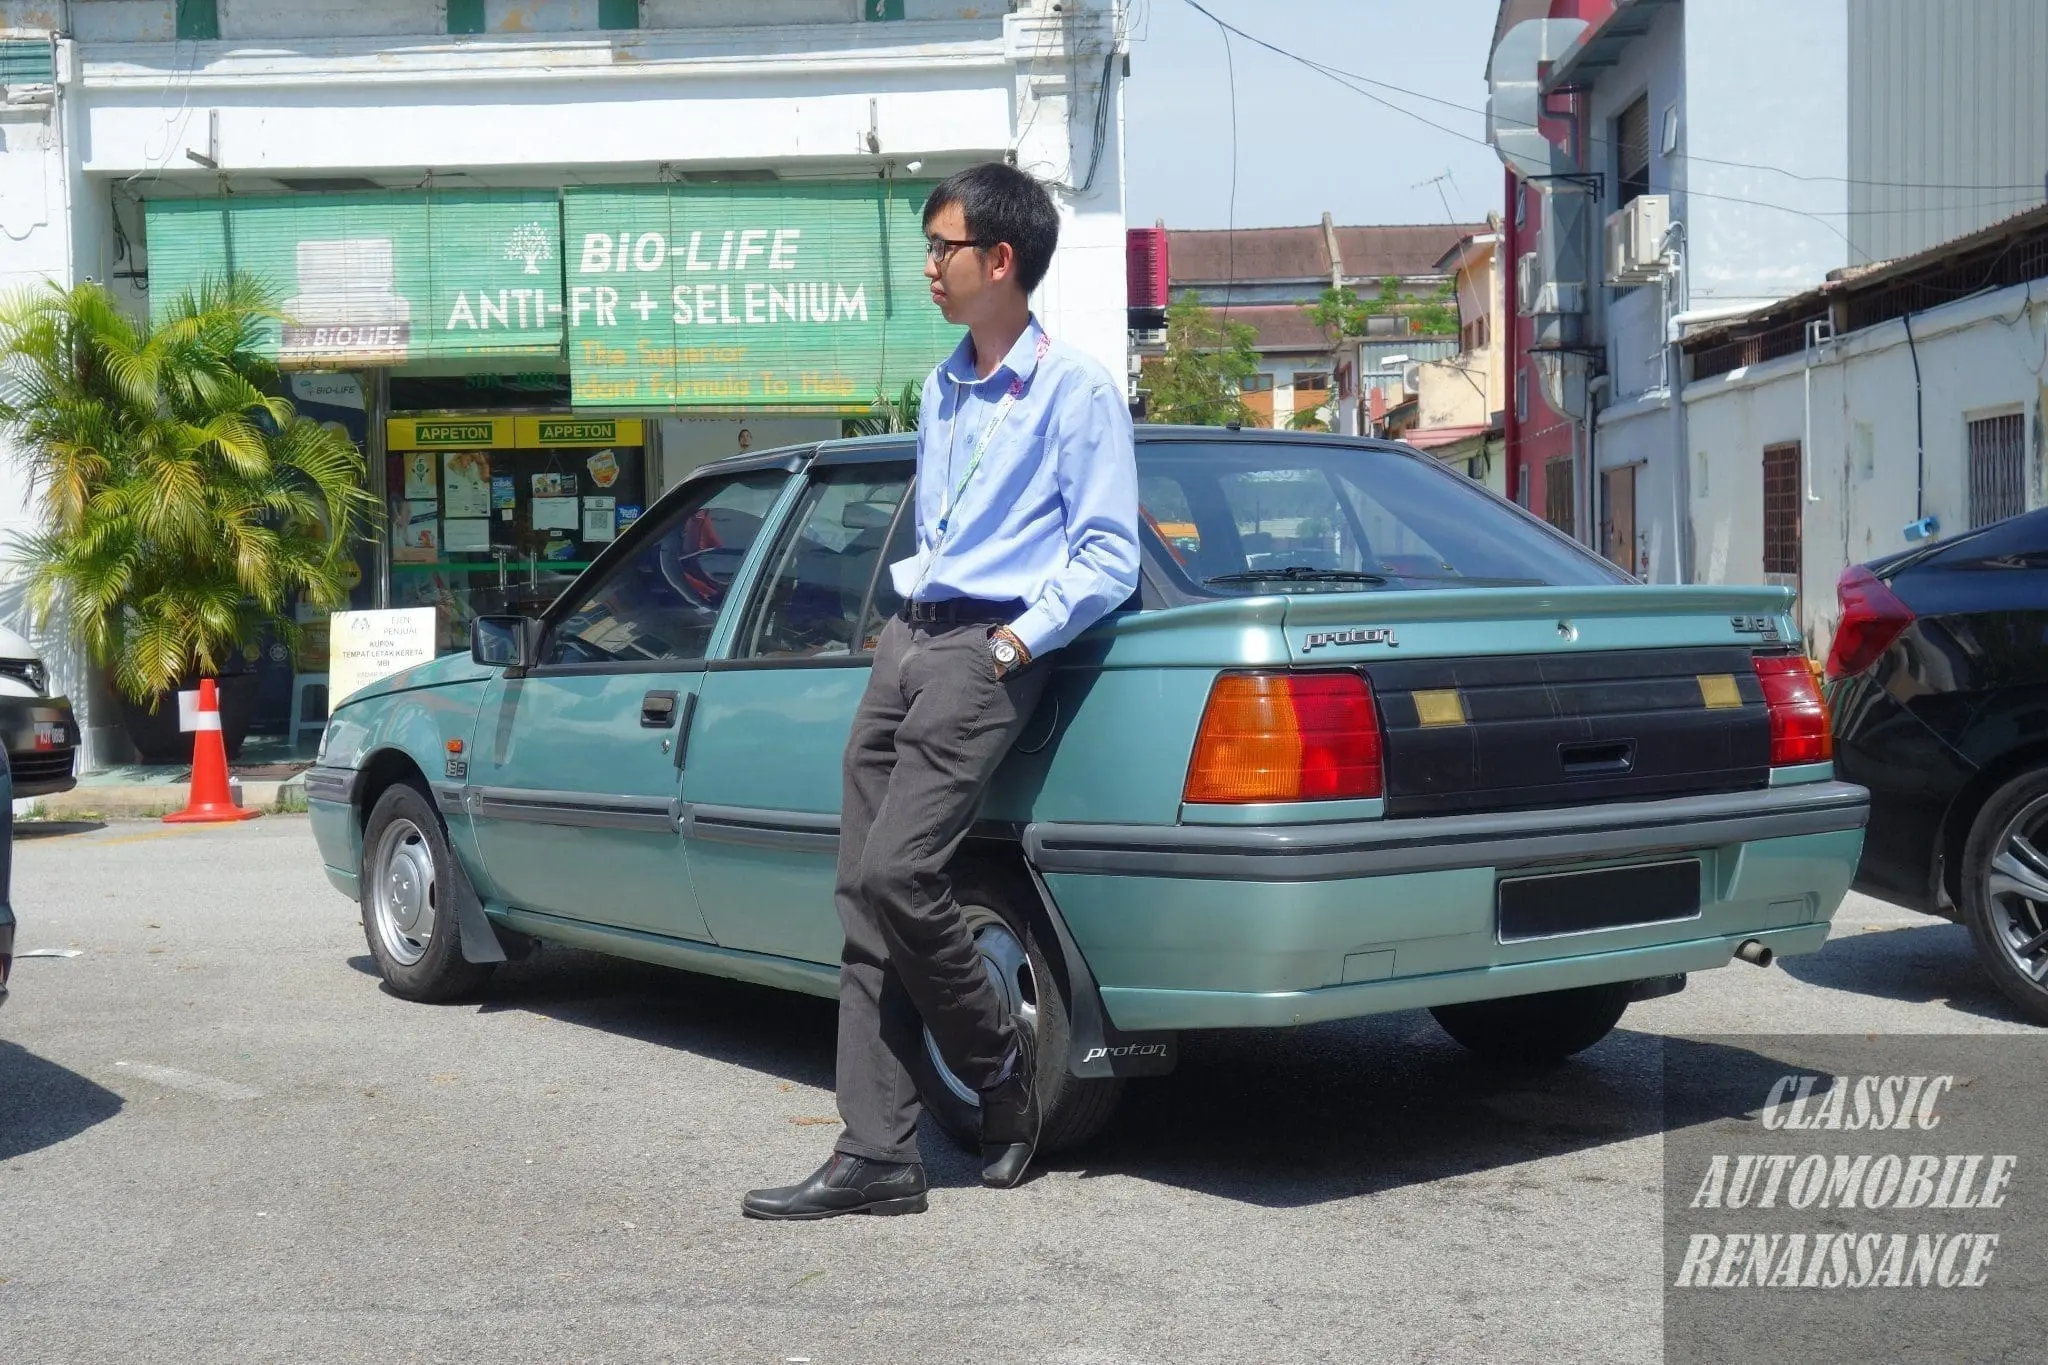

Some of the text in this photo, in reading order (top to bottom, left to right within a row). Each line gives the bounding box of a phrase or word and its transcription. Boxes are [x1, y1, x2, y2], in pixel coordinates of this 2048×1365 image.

[672, 280, 868, 324] SELENIUM
[580, 338, 747, 367] The Superior
[651, 371, 749, 398] Formula
[761, 370, 789, 395] To
[799, 369, 856, 397] Help
[420, 427, 489, 440] APPETON
[543, 424, 613, 437] APPETON
[1302, 627, 1399, 653] proton
[1082, 1043, 1168, 1063] proton
